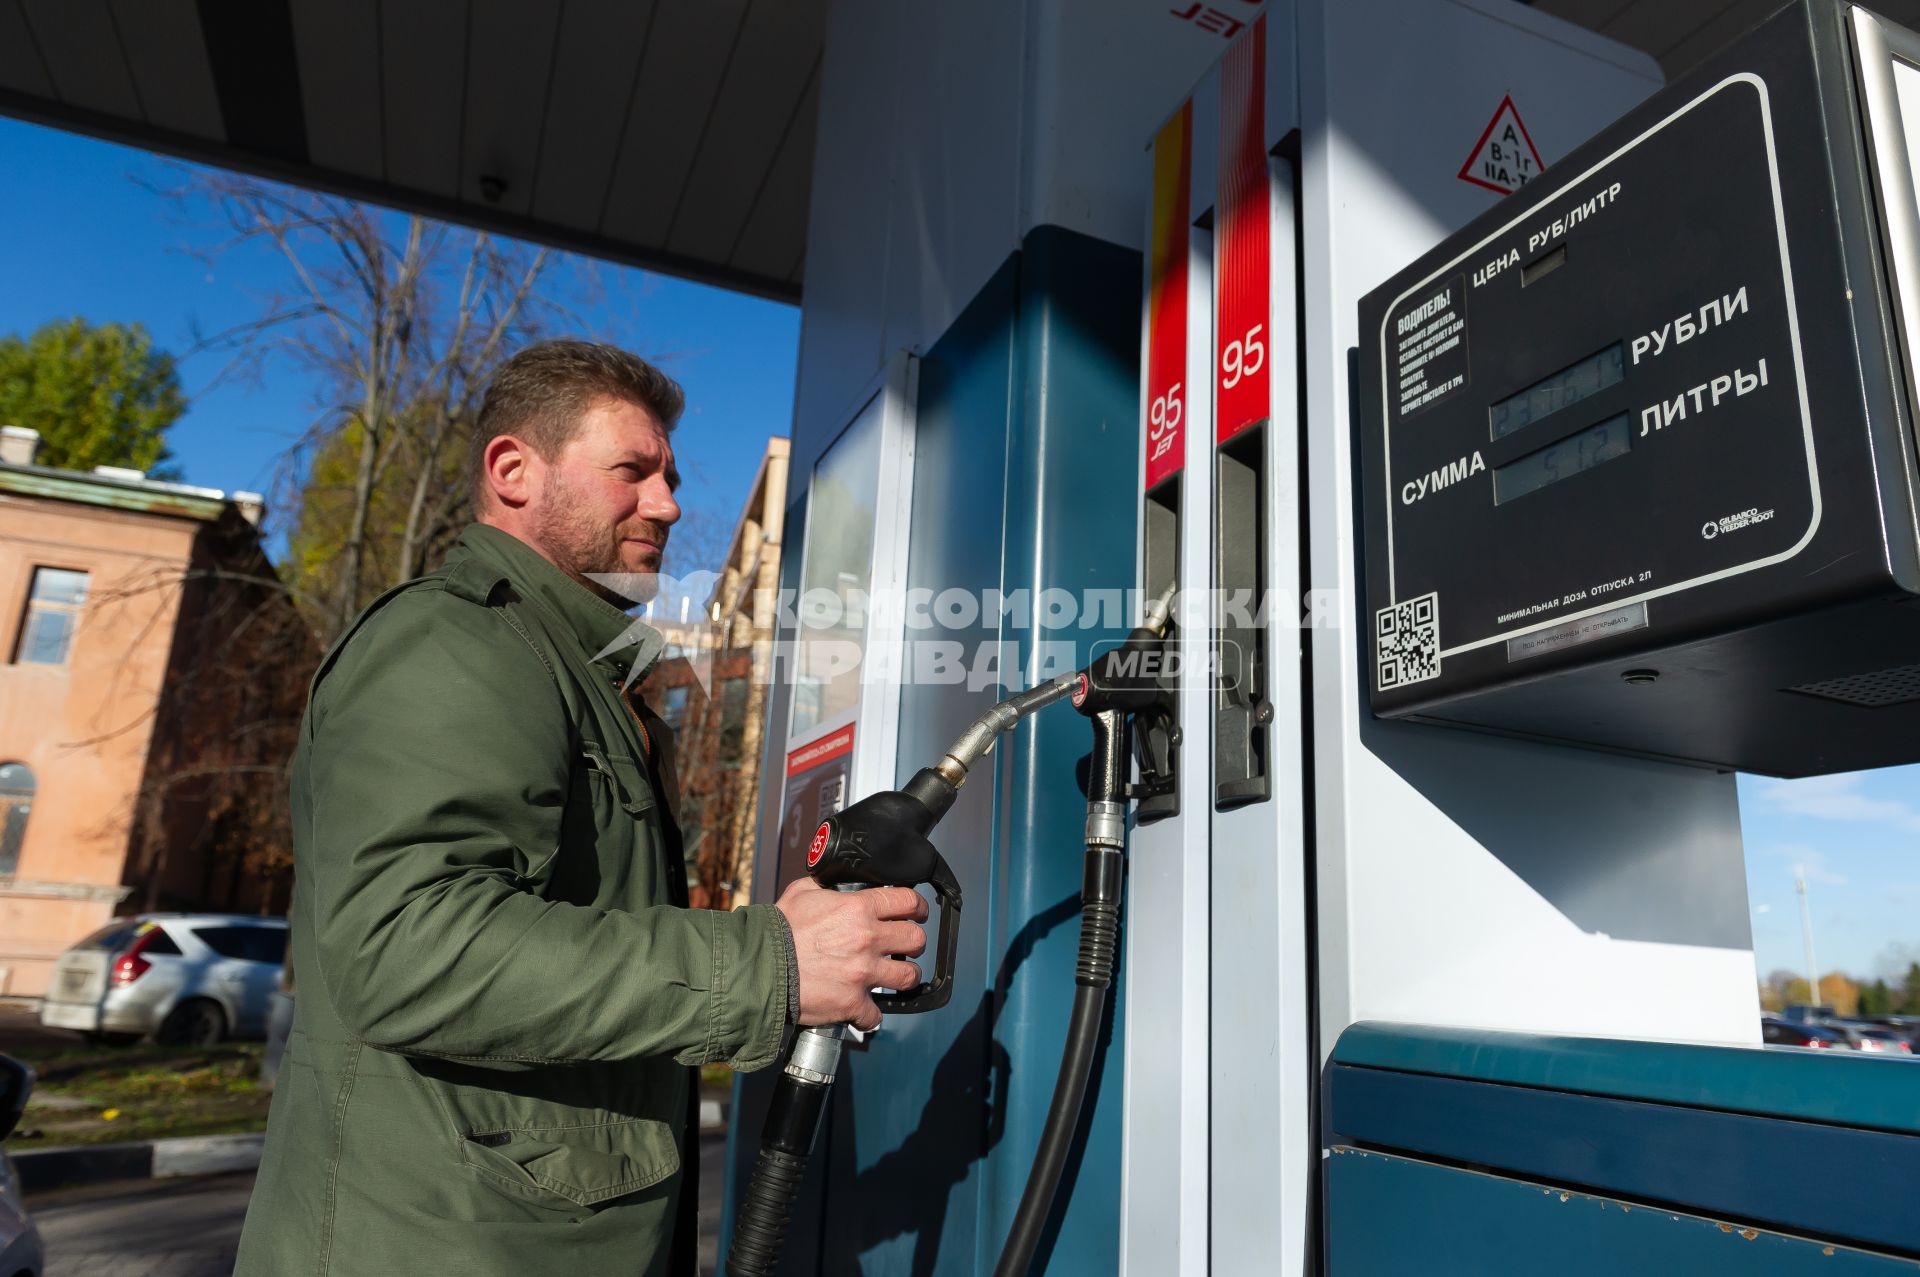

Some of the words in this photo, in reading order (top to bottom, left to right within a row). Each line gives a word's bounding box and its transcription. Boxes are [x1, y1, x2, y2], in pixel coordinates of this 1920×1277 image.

[1169, 3, 1246, 38] JET
[1485, 160, 1533, 185] IIA-T
[1473, 248, 1520, 287] ЦЕНА
[1529, 183, 1621, 253] РУБ/ЛИТР
[1397, 289, 1450, 336] ВОДИТЕЛЬ!
[1631, 286, 1749, 364] РУБЛИ
[1423, 329, 1447, 351] ПИСТОЛЕТ
[1452, 317, 1464, 333] БАК
[1222, 323, 1264, 389] 95
[1151, 382, 1182, 440] 95
[1422, 382, 1447, 404] ПИСТОЛЕТ
[1639, 358, 1769, 437] ЛИТРЫ
[1151, 430, 1177, 462] JET
[1401, 451, 1485, 505] СУММА
[1719, 508, 1758, 526] GILBARCO
[1720, 510, 1775, 533] VEEDER-ROOT
[1497, 599, 1559, 624] МИНИМАЛЬНАЯ
[1563, 590, 1587, 605] ДОЗА
[1591, 576, 1635, 595] ОТПУСКА
[1639, 570, 1652, 582] 2Л
[811, 835, 824, 853] 95
